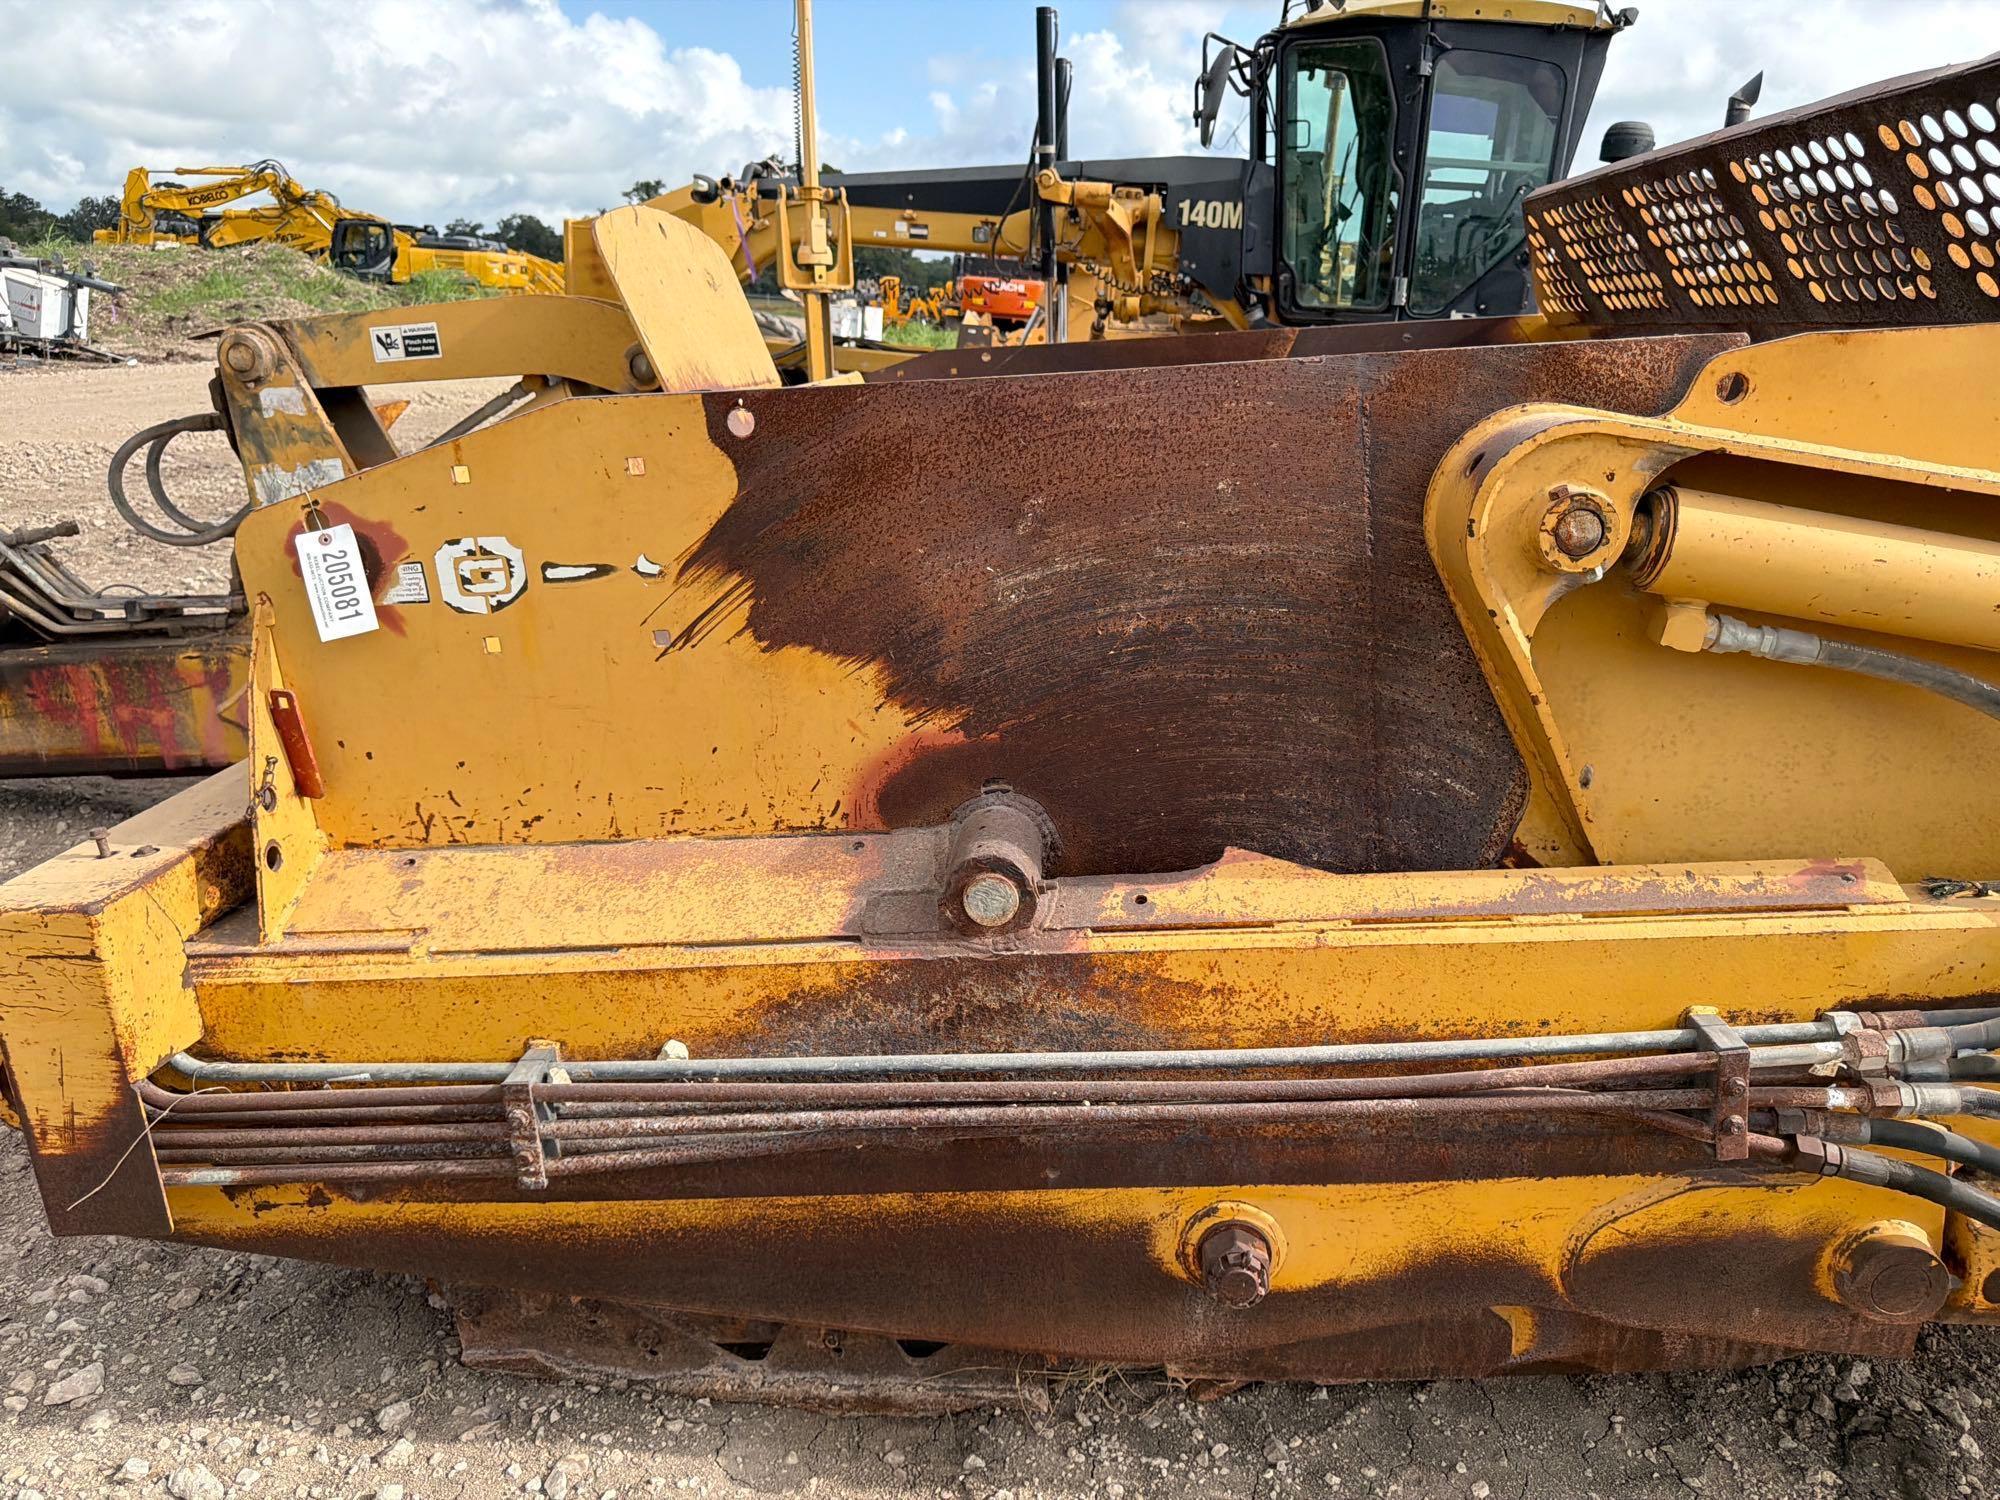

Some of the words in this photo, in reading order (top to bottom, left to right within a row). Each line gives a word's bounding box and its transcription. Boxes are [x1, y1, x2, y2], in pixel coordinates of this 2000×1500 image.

[187, 190, 229, 206] KOBELCO
[1178, 199, 1243, 230] 140M
[317, 573, 327, 596] AUCTION
[323, 596, 334, 622] COMPANY
[322, 550, 364, 621] 205081
